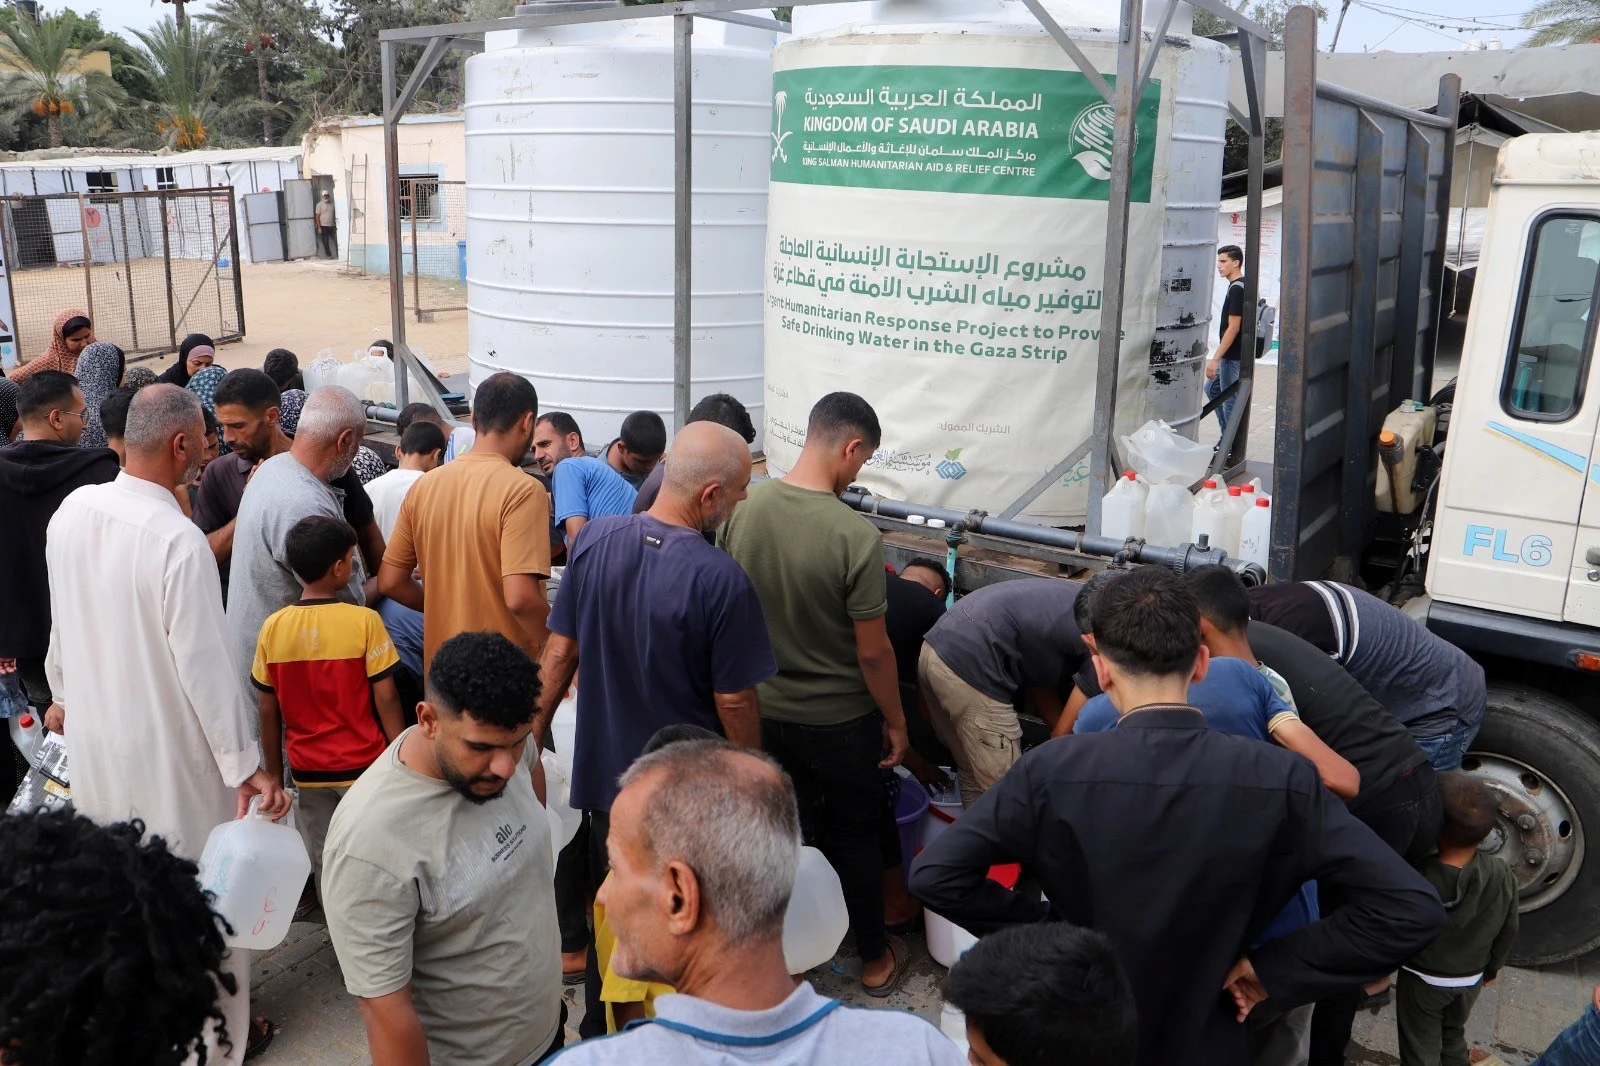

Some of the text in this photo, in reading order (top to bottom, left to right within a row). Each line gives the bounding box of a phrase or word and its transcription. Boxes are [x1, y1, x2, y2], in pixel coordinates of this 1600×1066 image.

[804, 86, 1042, 111] المملكة العربية السعودية
[803, 116, 1039, 139] KINGDOM OF SAUDI ARABIA
[918, 145, 964, 156] سلمان
[965, 146, 1003, 159] الملك
[1004, 148, 1037, 162] مركز
[818, 157, 849, 167] SALMAN
[850, 159, 923, 171] HUMANITARIAN
[925, 162, 944, 172] AID
[945, 163, 953, 173] &
[955, 164, 991, 174] RELIEF
[992, 165, 1036, 177] CENTRE
[779, 234, 1086, 282] مشروع الإستجابة الإنسانية العاجلة
[785, 265, 816, 288] قطاع
[818, 272, 845, 298] في
[906, 281, 977, 306] الشرب
[982, 286, 1031, 312] مياه
[1034, 288, 1102, 315] لتوفير
[784, 297, 862, 323] Humanitarian
[865, 310, 952, 333] Response
[956, 319, 1029, 340] Project
[1033, 325, 1054, 339] to
[1058, 325, 1126, 341] Prove
[781, 315, 1068, 364] Safe Drinking Water in the Gaza Strip
[975, 423, 1011, 435] الشريك
[1463, 524, 1553, 567] FL6
[495, 823, 513, 845] alo
